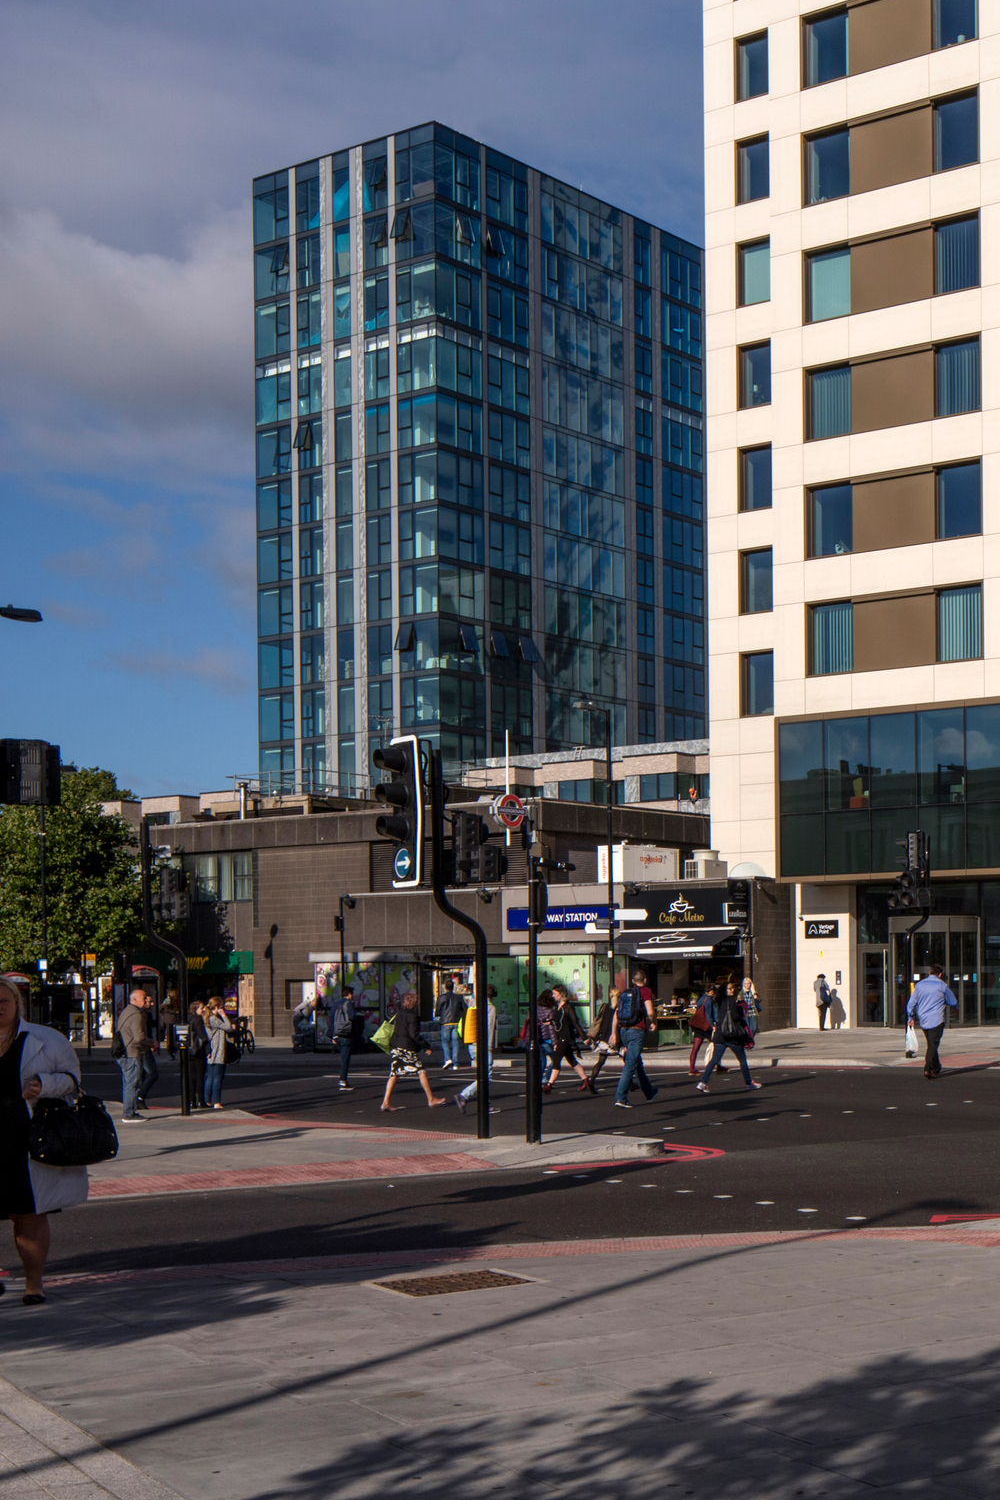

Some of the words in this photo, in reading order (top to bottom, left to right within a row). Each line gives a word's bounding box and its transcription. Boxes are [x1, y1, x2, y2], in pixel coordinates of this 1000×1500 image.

[565, 913, 598, 922] STATION
[659, 912, 677, 925] Cafe
[679, 911, 705, 922] Metro
